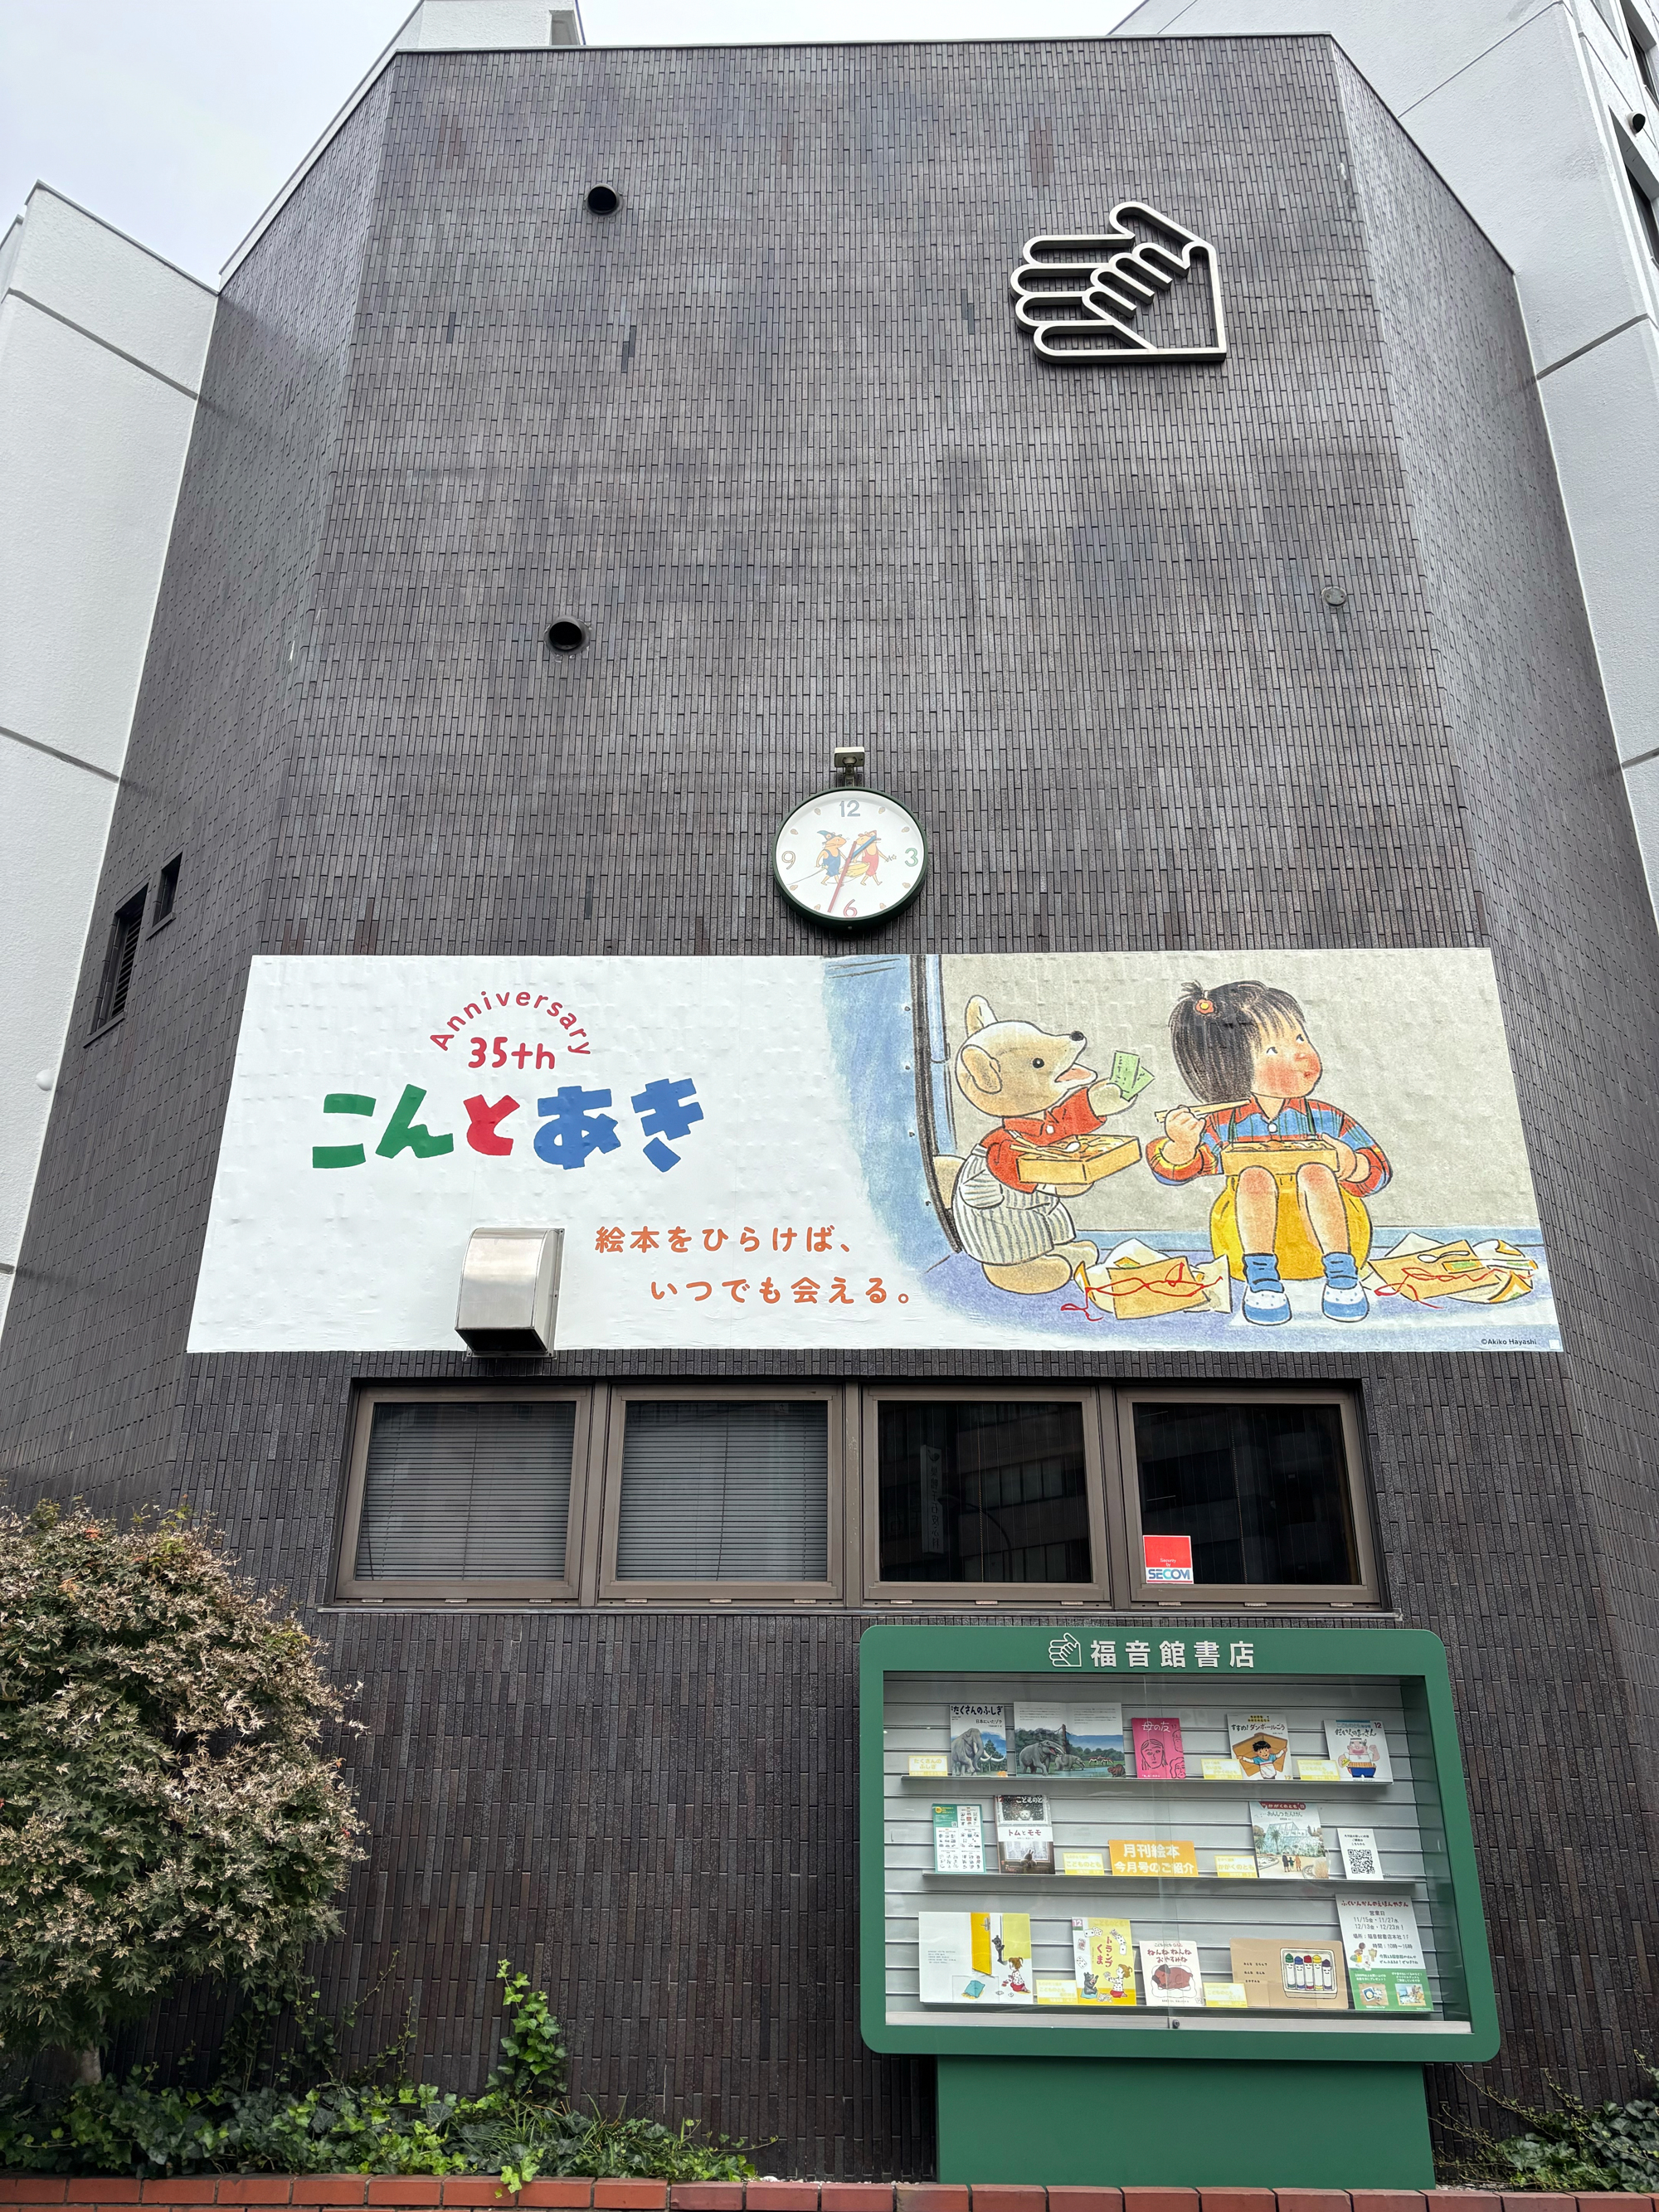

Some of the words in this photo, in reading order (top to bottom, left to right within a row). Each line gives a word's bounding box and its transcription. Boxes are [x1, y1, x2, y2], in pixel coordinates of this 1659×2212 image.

[839, 800, 860, 817] 12
[781, 851, 796, 869] 9
[905, 848, 918, 867] 3
[843, 899, 857, 917] 6
[430, 991, 591, 1054] Anniversary
[468, 1037, 555, 1069] 35th
[313, 1078, 703, 1173] こんとあき
[595, 1225, 849, 1253] 絵本をひらけば、
[650, 1276, 909, 1305] いつでも会える。
[1148, 1568, 1190, 1580] SECOM
[1091, 1640, 1254, 1668] 福音館書店
[953, 1705, 1004, 1716] たくさんのふしぎ
[1123, 1844, 1180, 1859] 月刊絵本
[1114, 1861, 1194, 1874] 今月号のご紹介
[1096, 1943, 1103, 1965] くま
